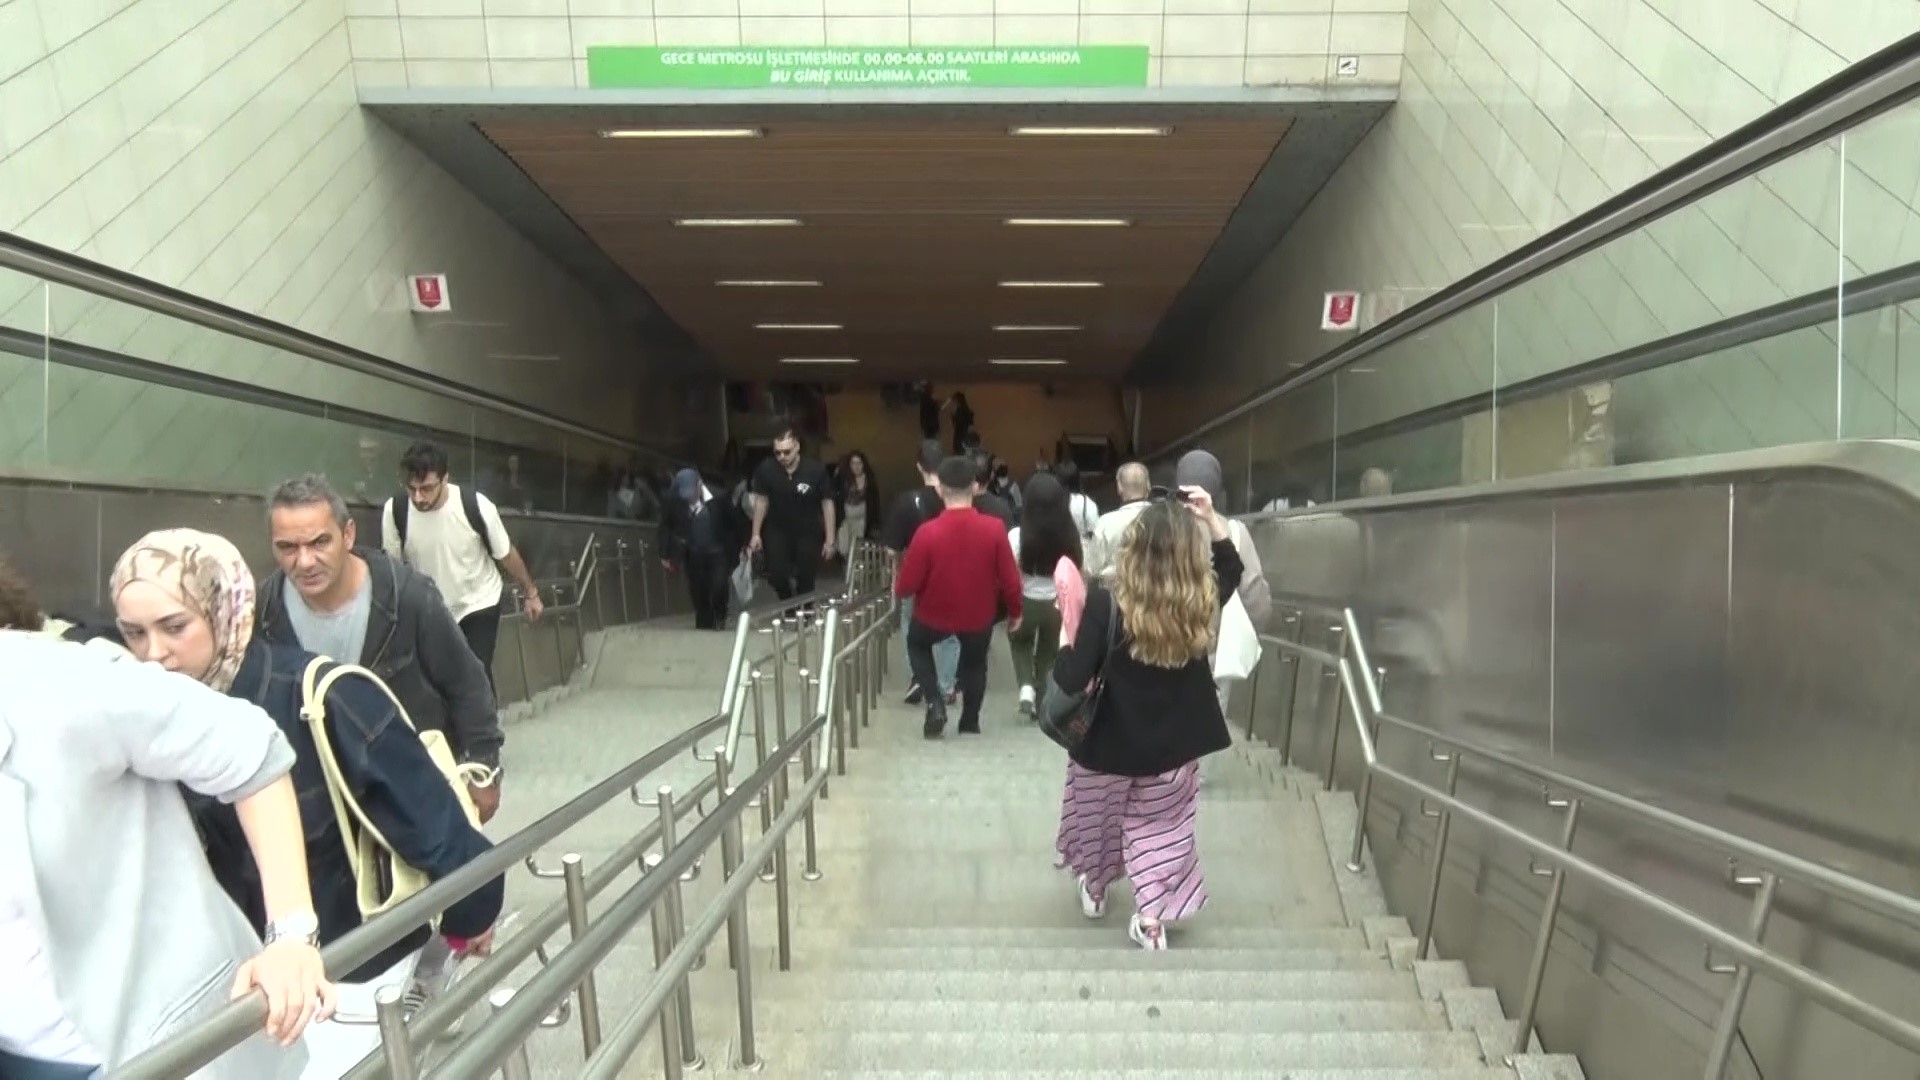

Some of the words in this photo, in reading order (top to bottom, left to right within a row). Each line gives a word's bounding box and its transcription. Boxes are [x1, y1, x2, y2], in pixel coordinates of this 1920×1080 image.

[661, 52, 694, 65] GECE
[698, 52, 763, 65] METROSU
[766, 50, 859, 68] İŞLETMESİNDE
[863, 52, 944, 65] 00.00-06.00
[947, 50, 1008, 65] SAATLERİ
[1011, 51, 1081, 65] ARASINDA
[770, 70, 789, 83] BU
[794, 68, 832, 85] GİRİŞ
[835, 69, 913, 82] KULLANIMA
[916, 69, 972, 85] AÇIKTIR.
